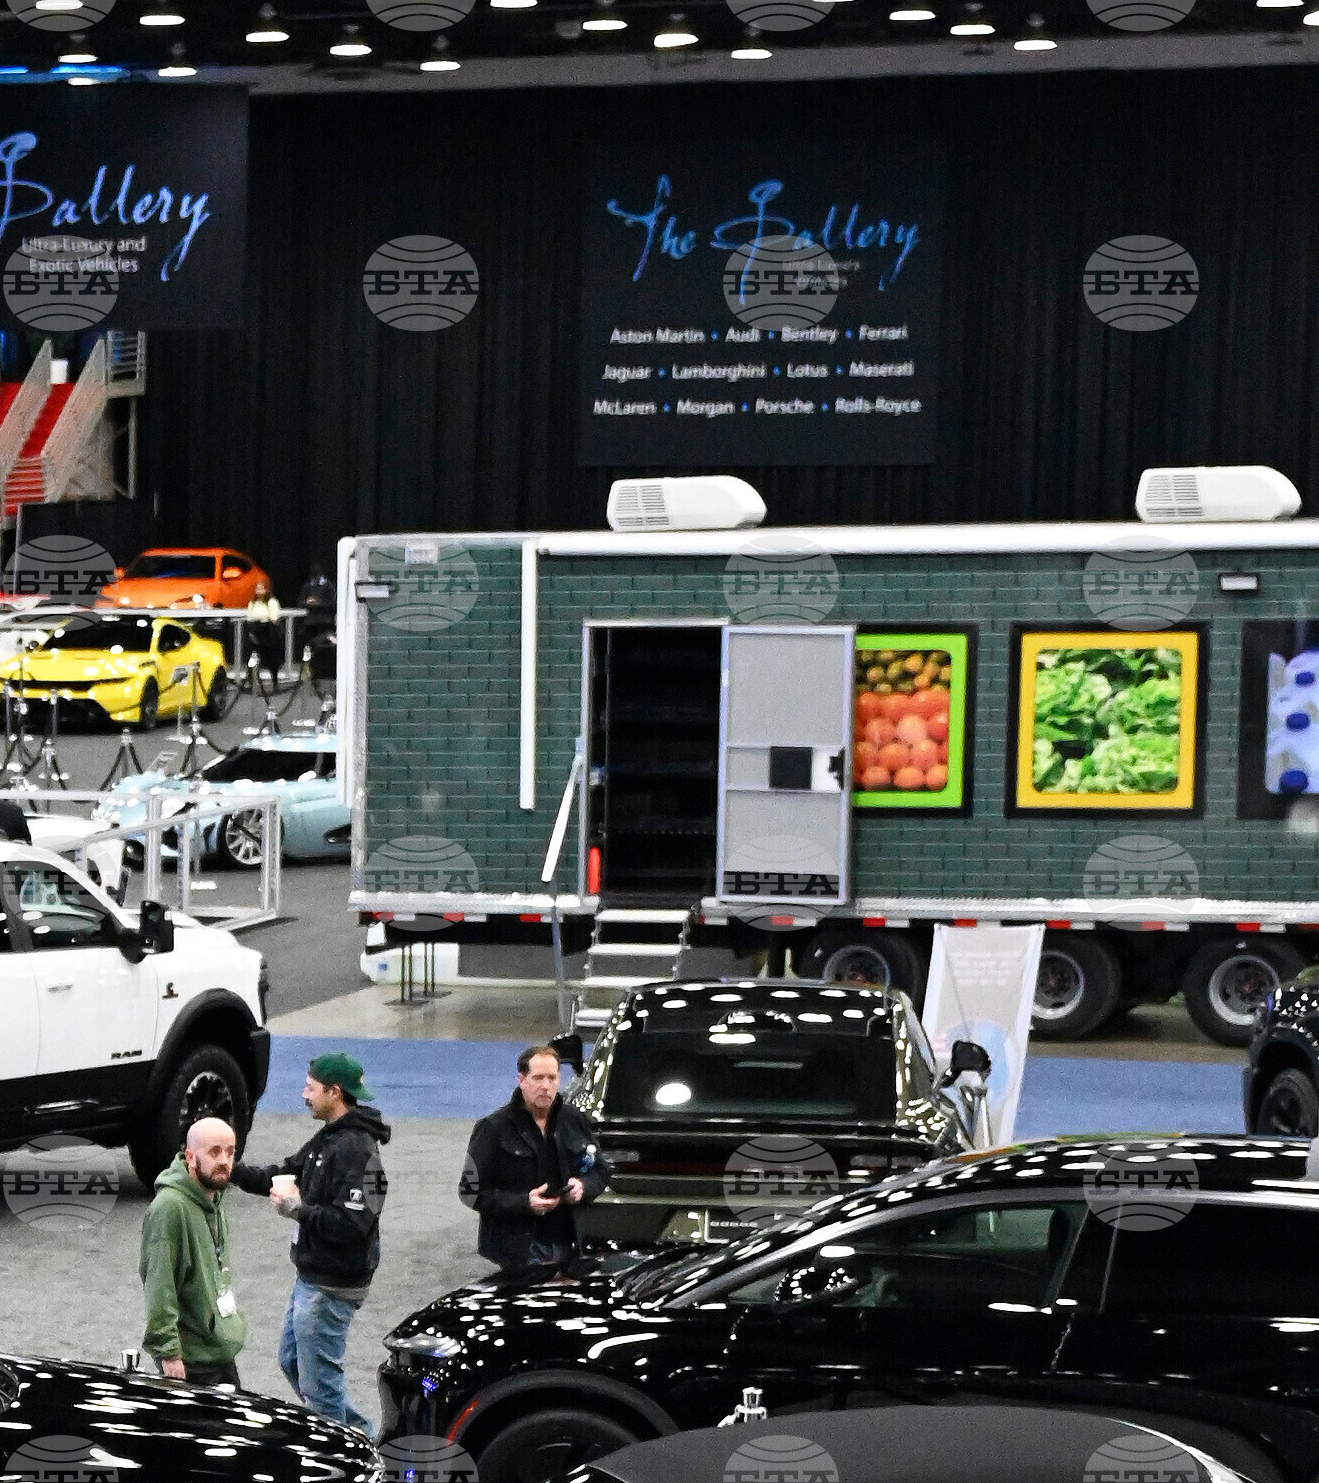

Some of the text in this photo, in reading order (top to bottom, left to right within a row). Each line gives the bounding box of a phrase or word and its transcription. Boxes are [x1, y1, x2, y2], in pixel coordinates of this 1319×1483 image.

[606, 173, 696, 282] The
[116, 236, 147, 253] and
[29, 256, 139, 274] Exotic Vehicles
[610, 324, 908, 344] Aston Martin Audi Bentley Ferrari
[602, 361, 914, 383] Jaguar Lamborghini Lotus Maserati
[593, 400, 657, 415] McLaren
[676, 399, 735, 418] Morgan
[755, 399, 814, 414] Porsche
[111, 1050, 142, 1059] RAM
